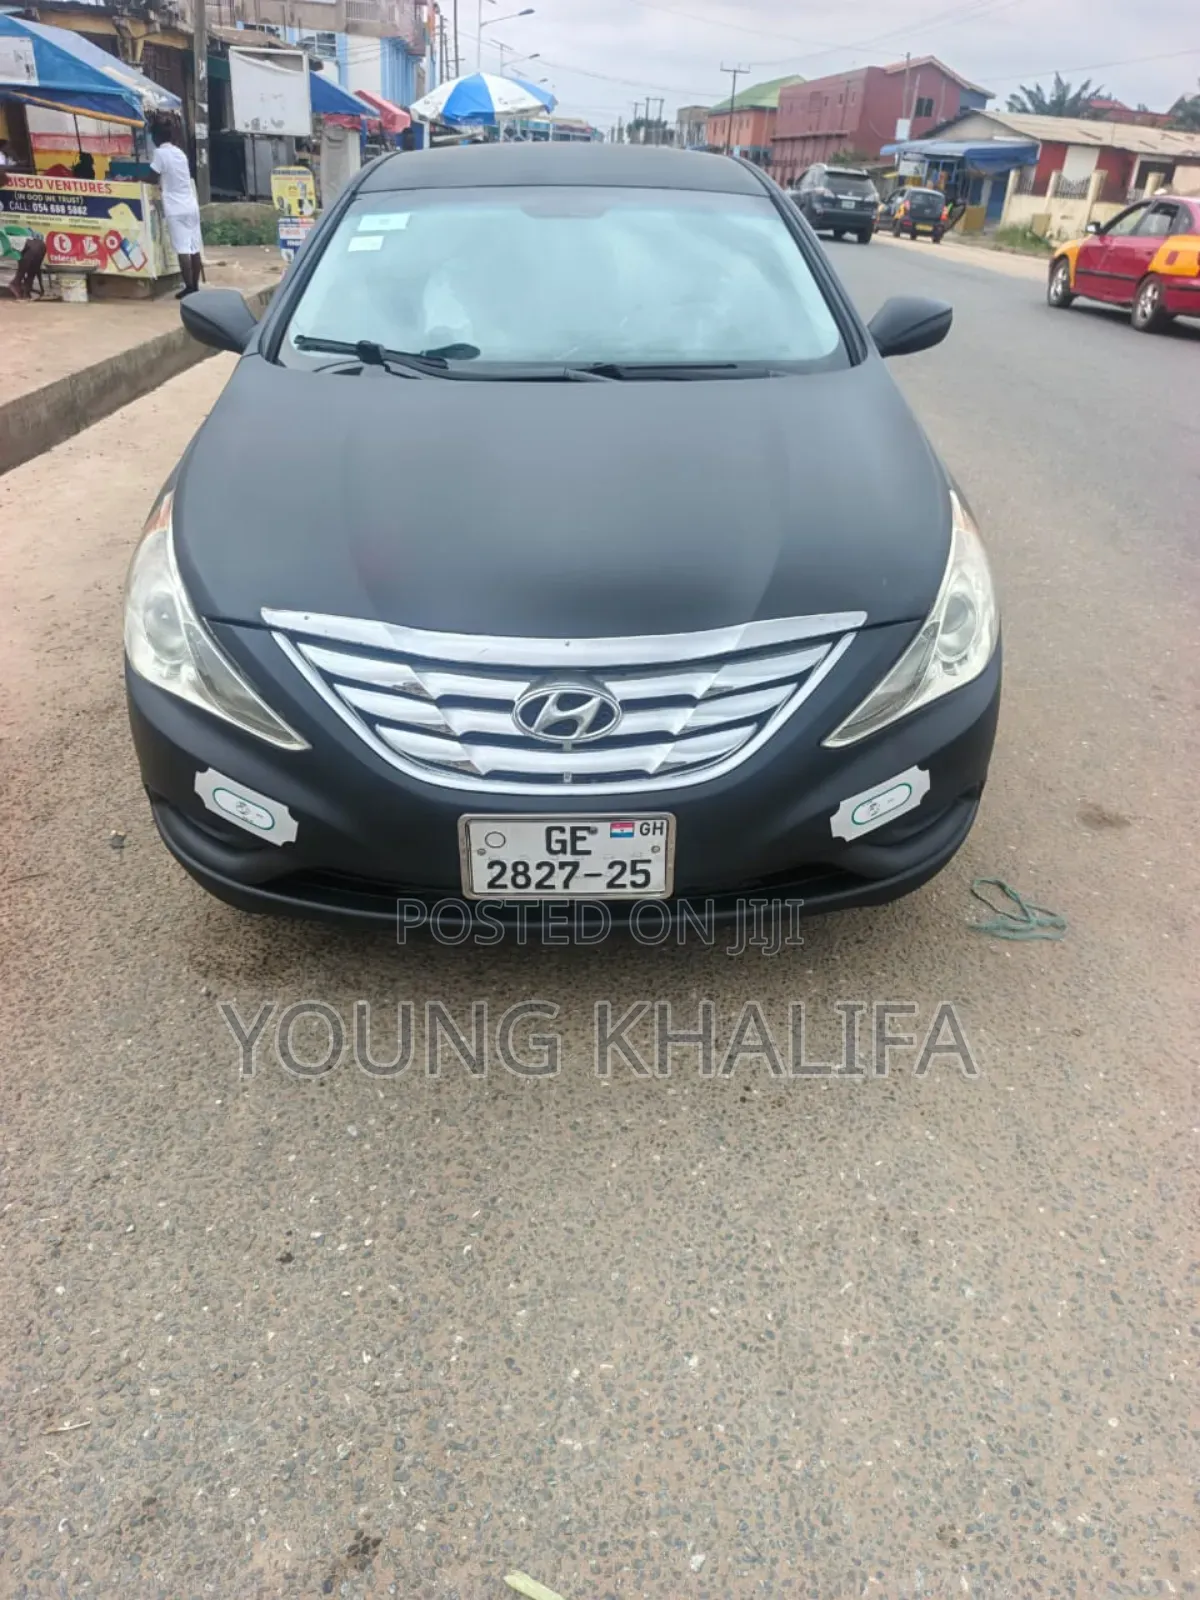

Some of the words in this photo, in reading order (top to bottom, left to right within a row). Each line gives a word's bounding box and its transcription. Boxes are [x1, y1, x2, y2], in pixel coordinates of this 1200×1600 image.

[47, 179, 113, 194] VENTURES
[32, 202, 49, 213] 054
[544, 825, 593, 856] GE
[639, 821, 665, 837] GH
[486, 858, 653, 891] 2827-25
